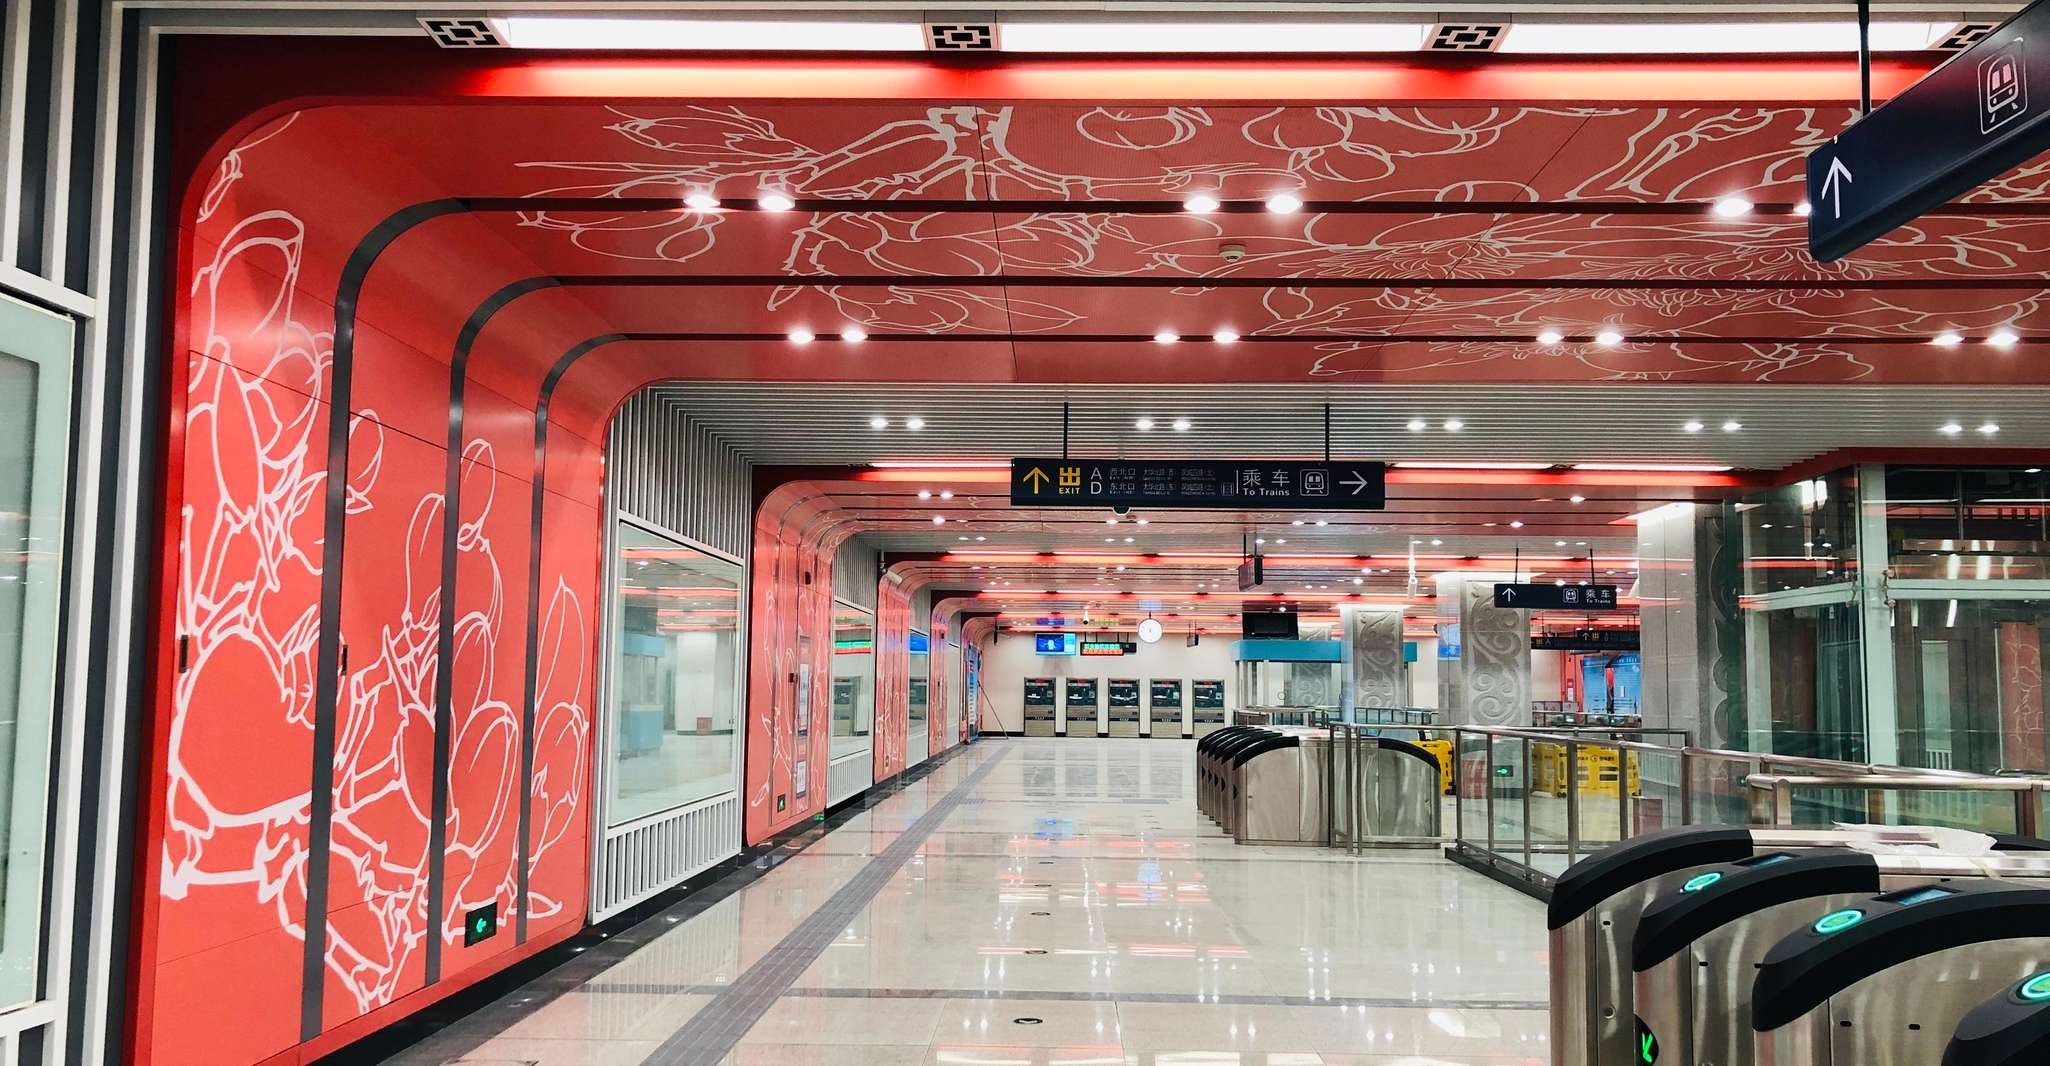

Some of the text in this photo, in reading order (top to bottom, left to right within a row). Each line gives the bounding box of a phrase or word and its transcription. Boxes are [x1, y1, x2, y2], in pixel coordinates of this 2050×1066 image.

[1059, 467, 1081, 486] 出
[1090, 467, 1103, 480] A
[1090, 482, 1103, 495] D
[1243, 488, 1290, 496] To Trains
